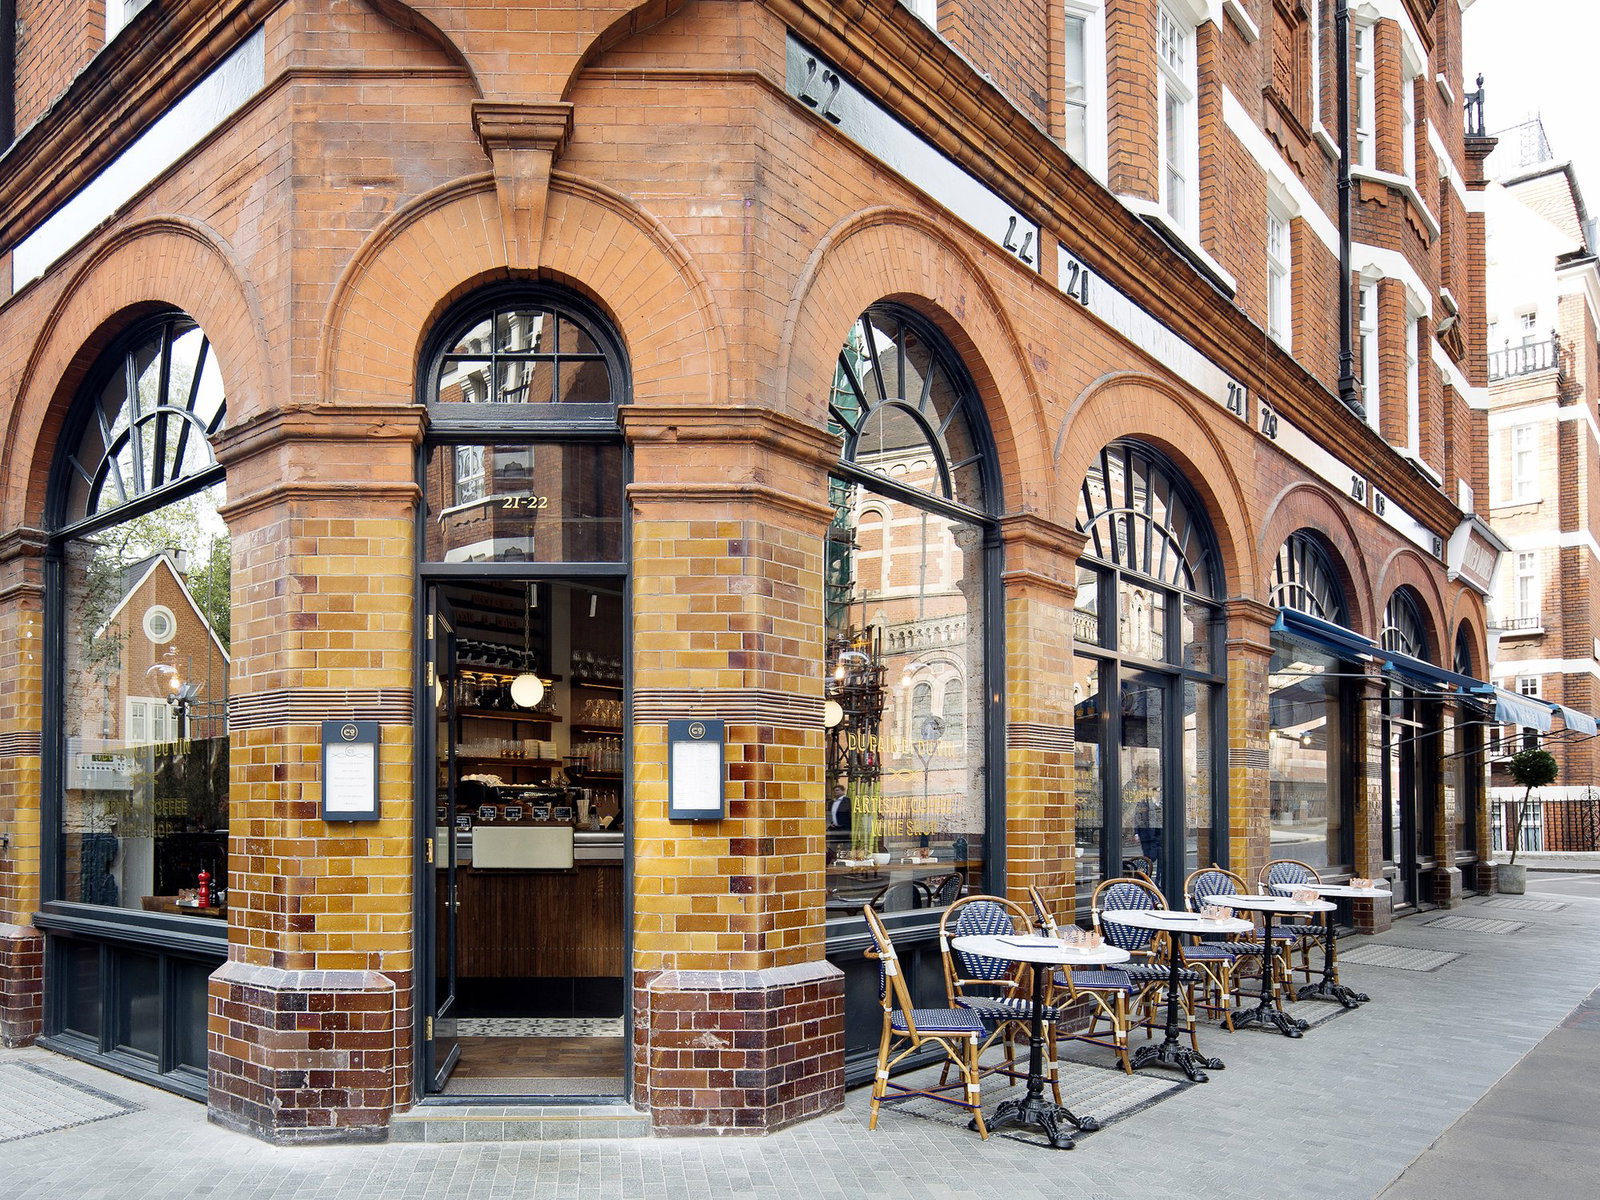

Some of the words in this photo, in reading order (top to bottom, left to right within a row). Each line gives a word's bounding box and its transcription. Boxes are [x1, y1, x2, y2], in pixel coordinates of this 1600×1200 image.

[799, 57, 842, 125] 22
[1002, 215, 1033, 264] 22
[1067, 259, 1089, 306] 21
[1226, 381, 1243, 416] 21
[1261, 407, 1278, 440] 20
[502, 496, 548, 509] 21-22
[847, 732, 866, 751] DU
[853, 796, 907, 814] ARTISAN
